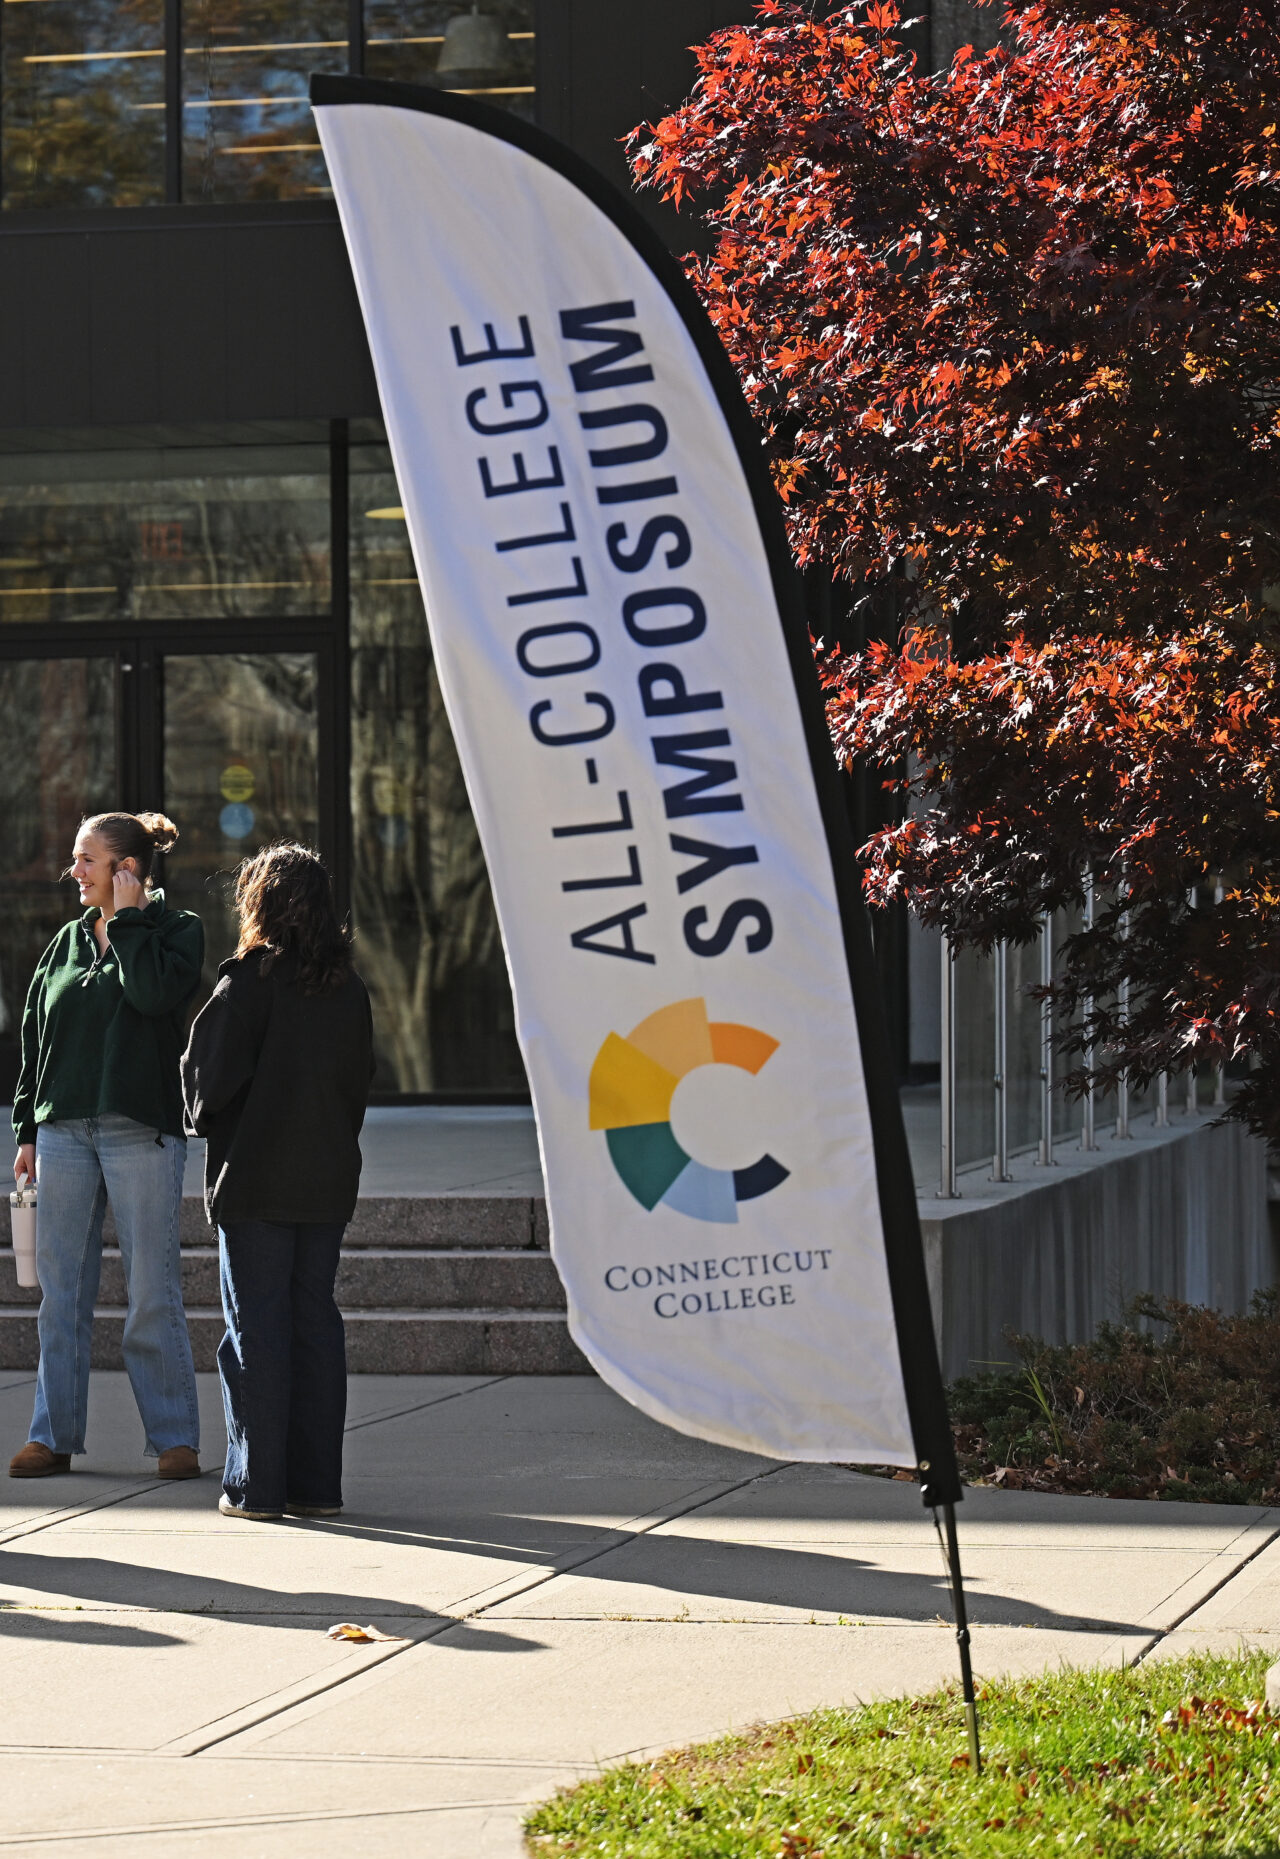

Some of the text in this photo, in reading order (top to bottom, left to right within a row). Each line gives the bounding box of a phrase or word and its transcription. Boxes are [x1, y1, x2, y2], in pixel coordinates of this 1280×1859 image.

[450, 315, 656, 965] ALL-COLLEGE
[559, 300, 773, 958] SYMPOSIUM
[604, 1249, 833, 1292] CONNECTICUT
[653, 1284, 797, 1319] COLLEGE
